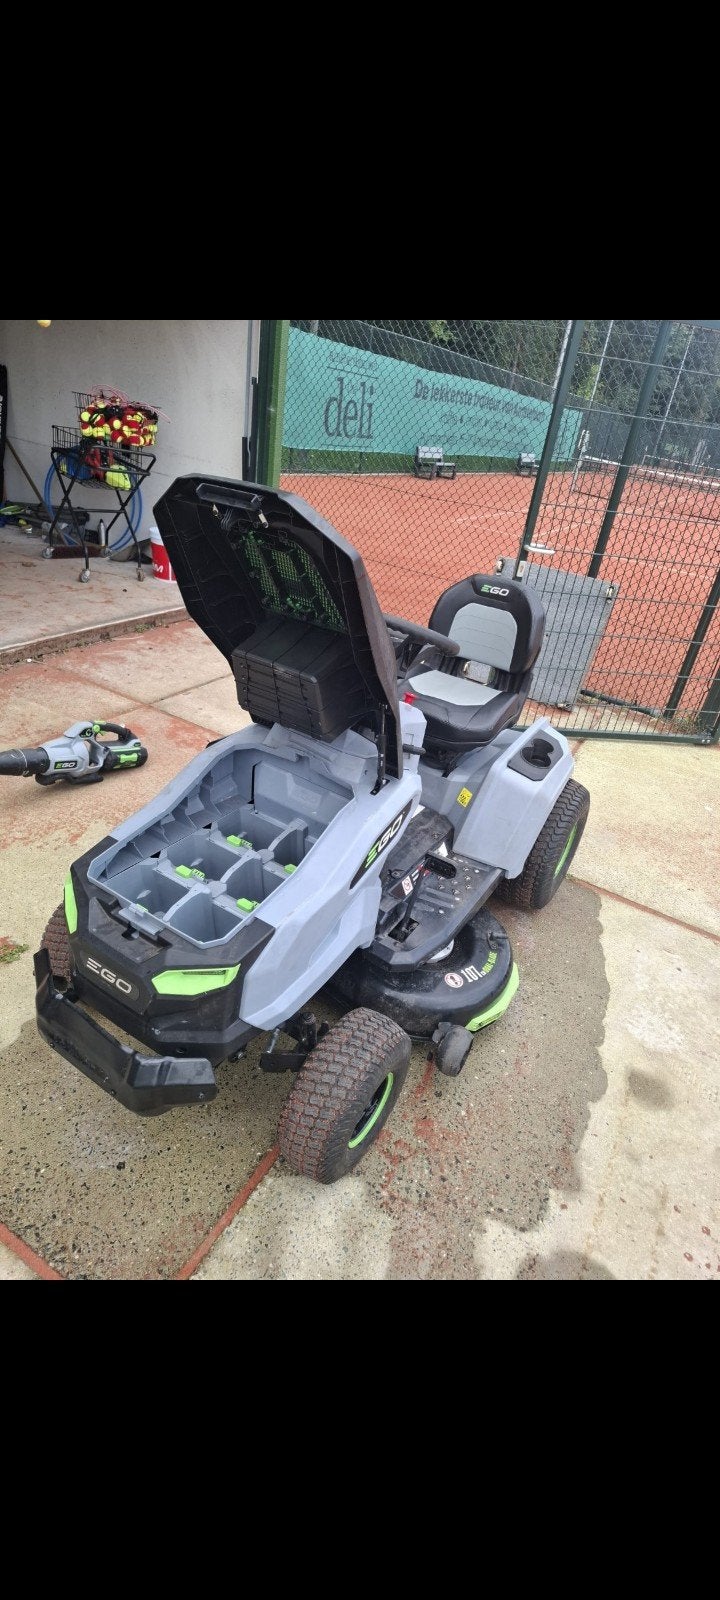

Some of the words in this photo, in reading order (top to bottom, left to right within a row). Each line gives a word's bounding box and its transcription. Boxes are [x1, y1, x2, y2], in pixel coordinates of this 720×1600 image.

[414, 379, 429, 400] De
[323, 376, 374, 439] deli
[480, 584, 510, 597] EGO
[55, 761, 76, 769] EGO
[364, 813, 403, 869] EGO
[86, 957, 132, 994] EGO
